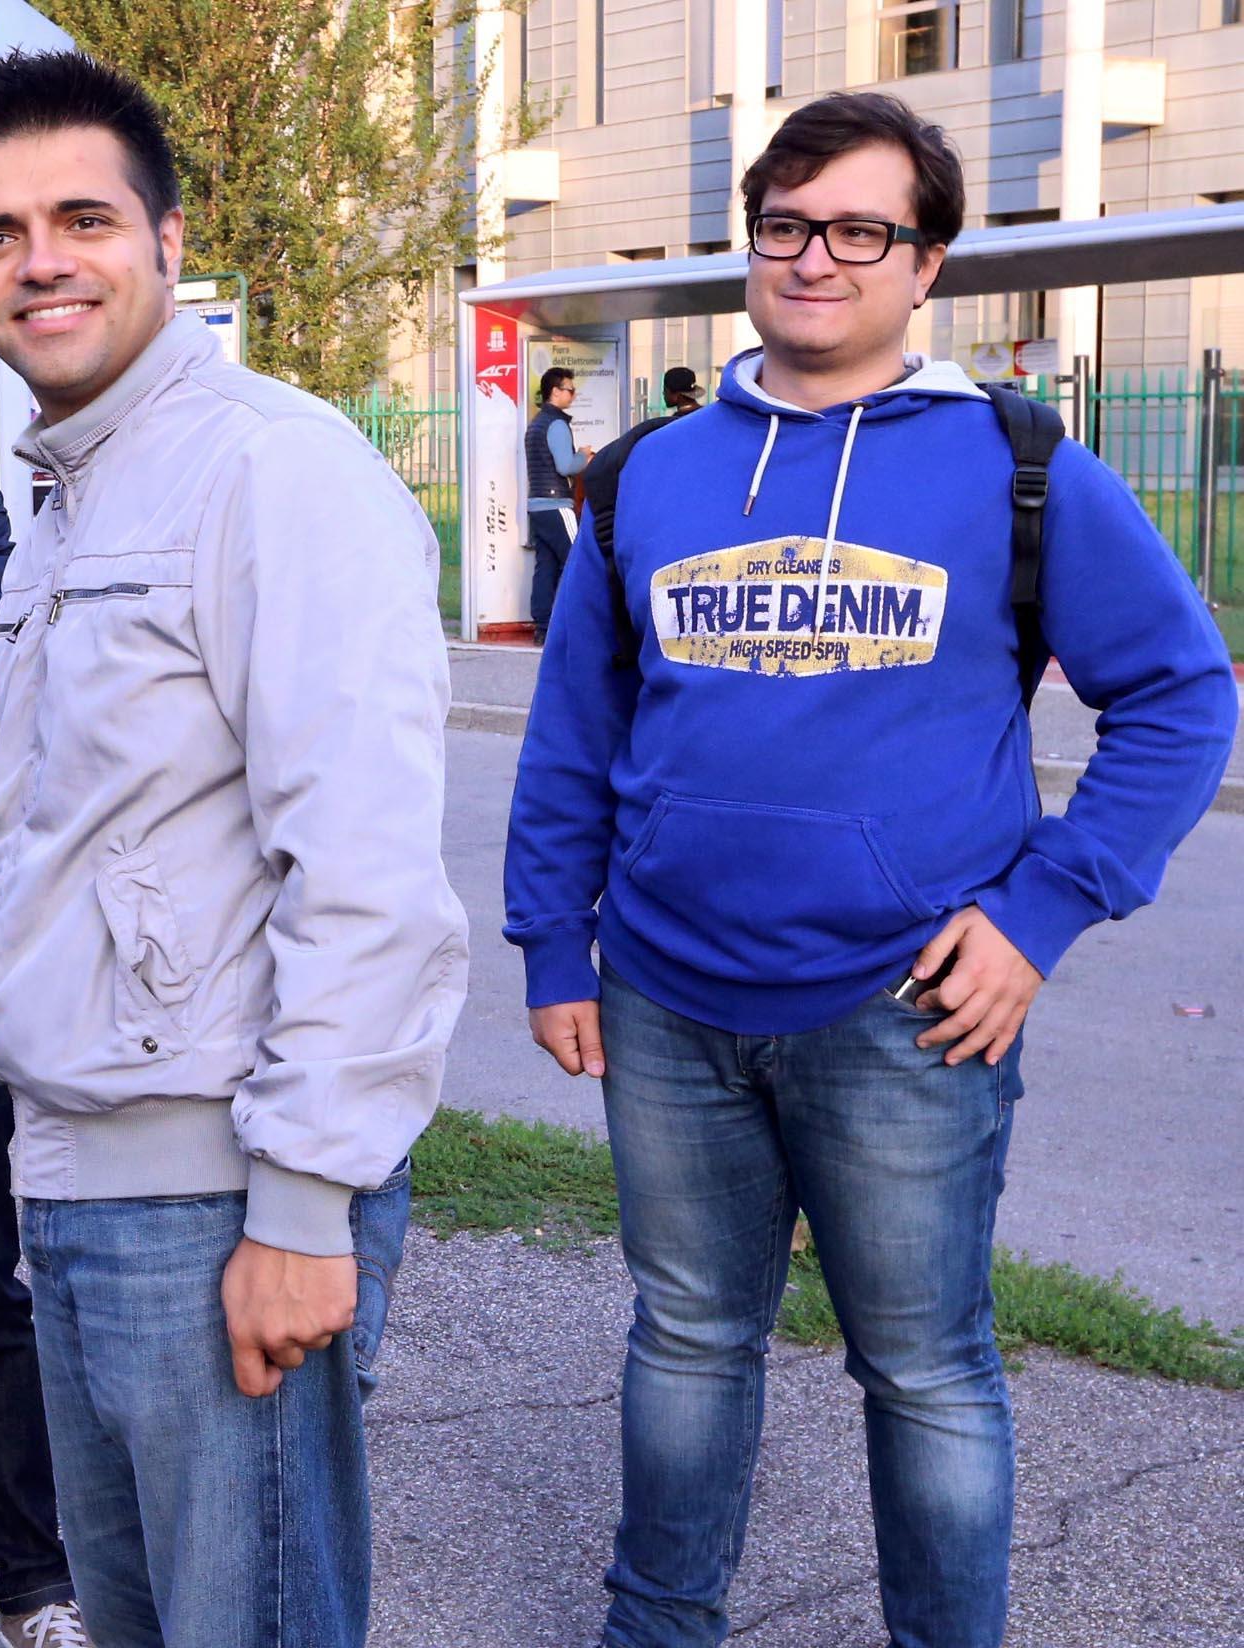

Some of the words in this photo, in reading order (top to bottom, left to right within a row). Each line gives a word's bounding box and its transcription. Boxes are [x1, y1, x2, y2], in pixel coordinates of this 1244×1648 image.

[476, 364, 518, 377] ACT
[747, 560, 772, 575] DRY
[667, 584, 772, 634] TRUE
[777, 582, 923, 638] DENIM
